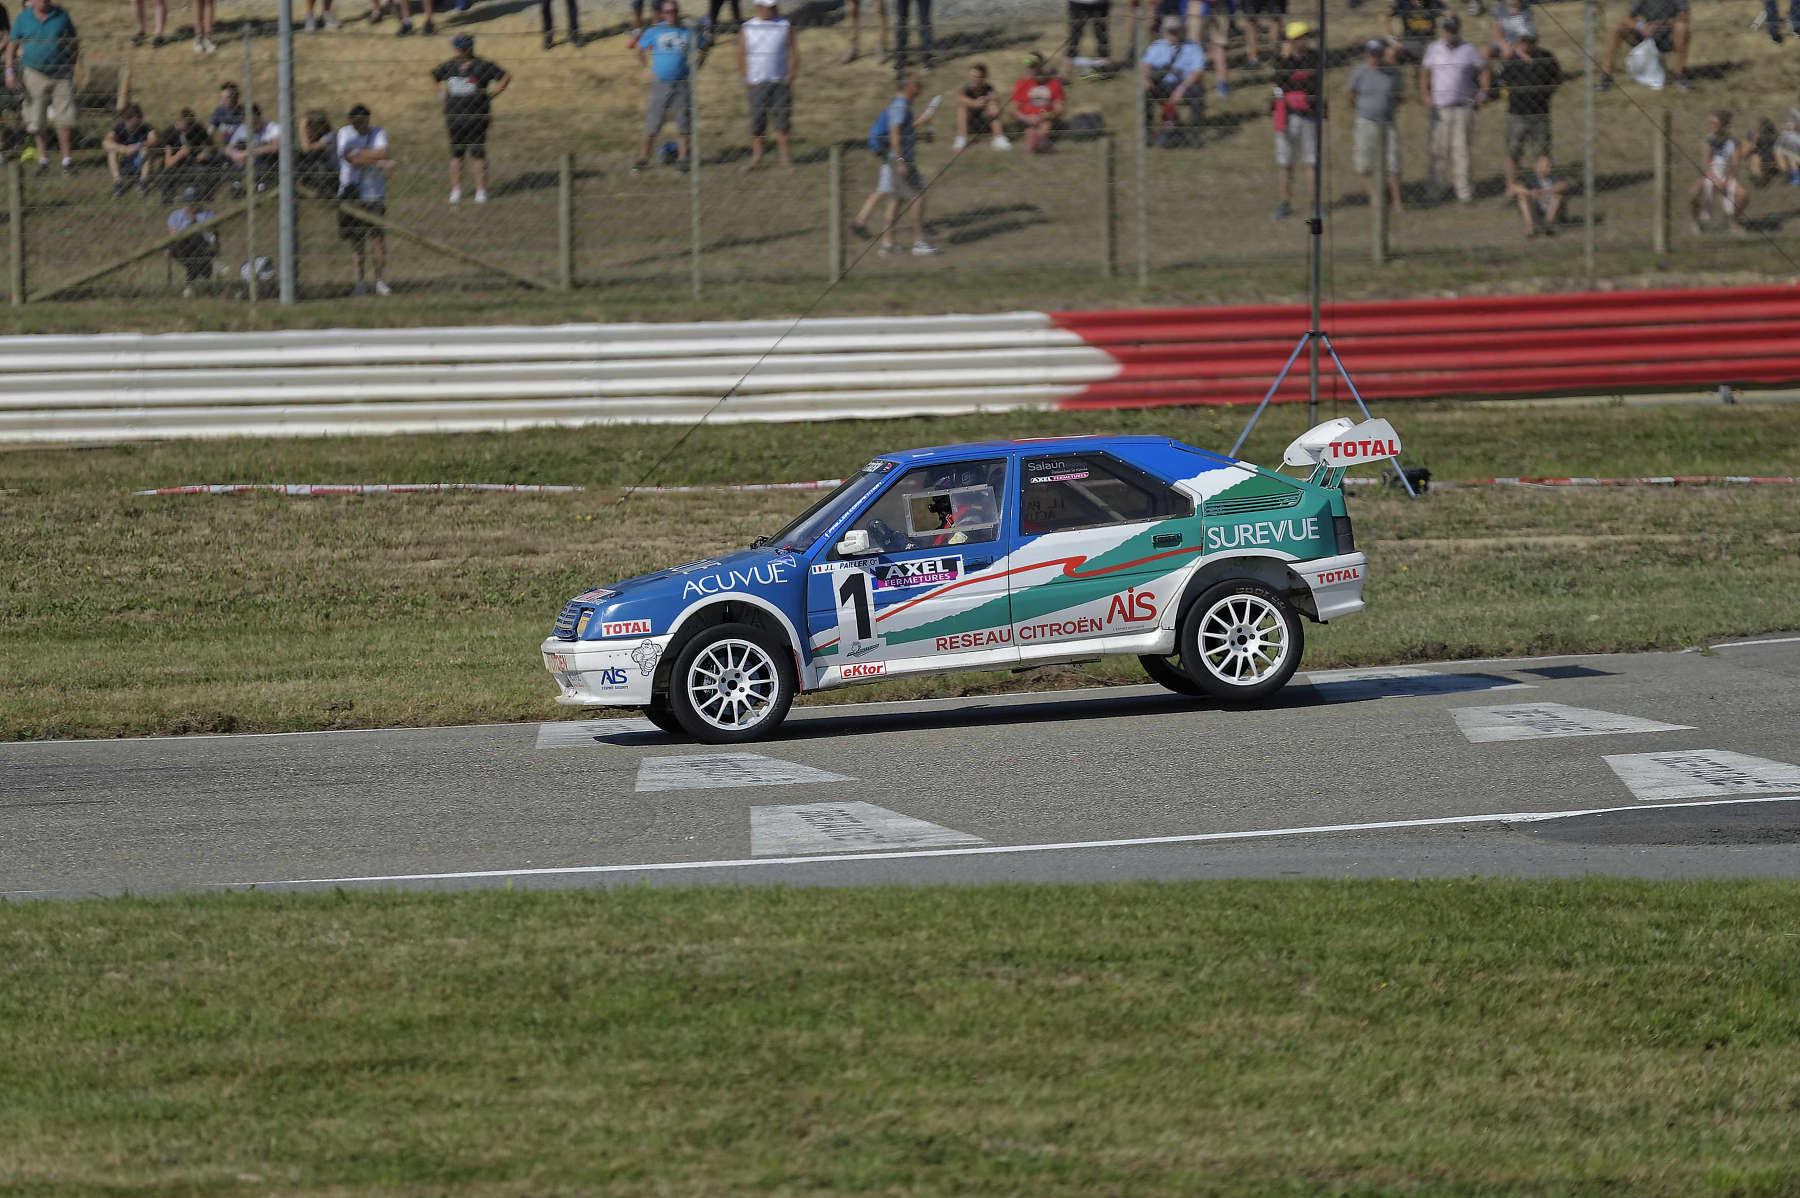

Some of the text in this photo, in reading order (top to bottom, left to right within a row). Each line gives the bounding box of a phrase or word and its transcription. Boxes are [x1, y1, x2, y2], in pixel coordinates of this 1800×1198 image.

[1328, 439, 1400, 458] TOTAL
[1031, 476, 1053, 484] AXEL
[1207, 517, 1321, 549] SUREVUE
[839, 560, 867, 569] PAILLER
[885, 558, 949, 579] AXEL
[682, 562, 788, 600] ACUVUE
[884, 573, 951, 587] FERMETURES
[1317, 568, 1360, 585] TOTAL
[839, 573, 872, 641] 1
[603, 621, 650, 635] TOTAL
[935, 616, 1103, 651] RESEAU CITROËN
[843, 664, 884, 677] eKtor
